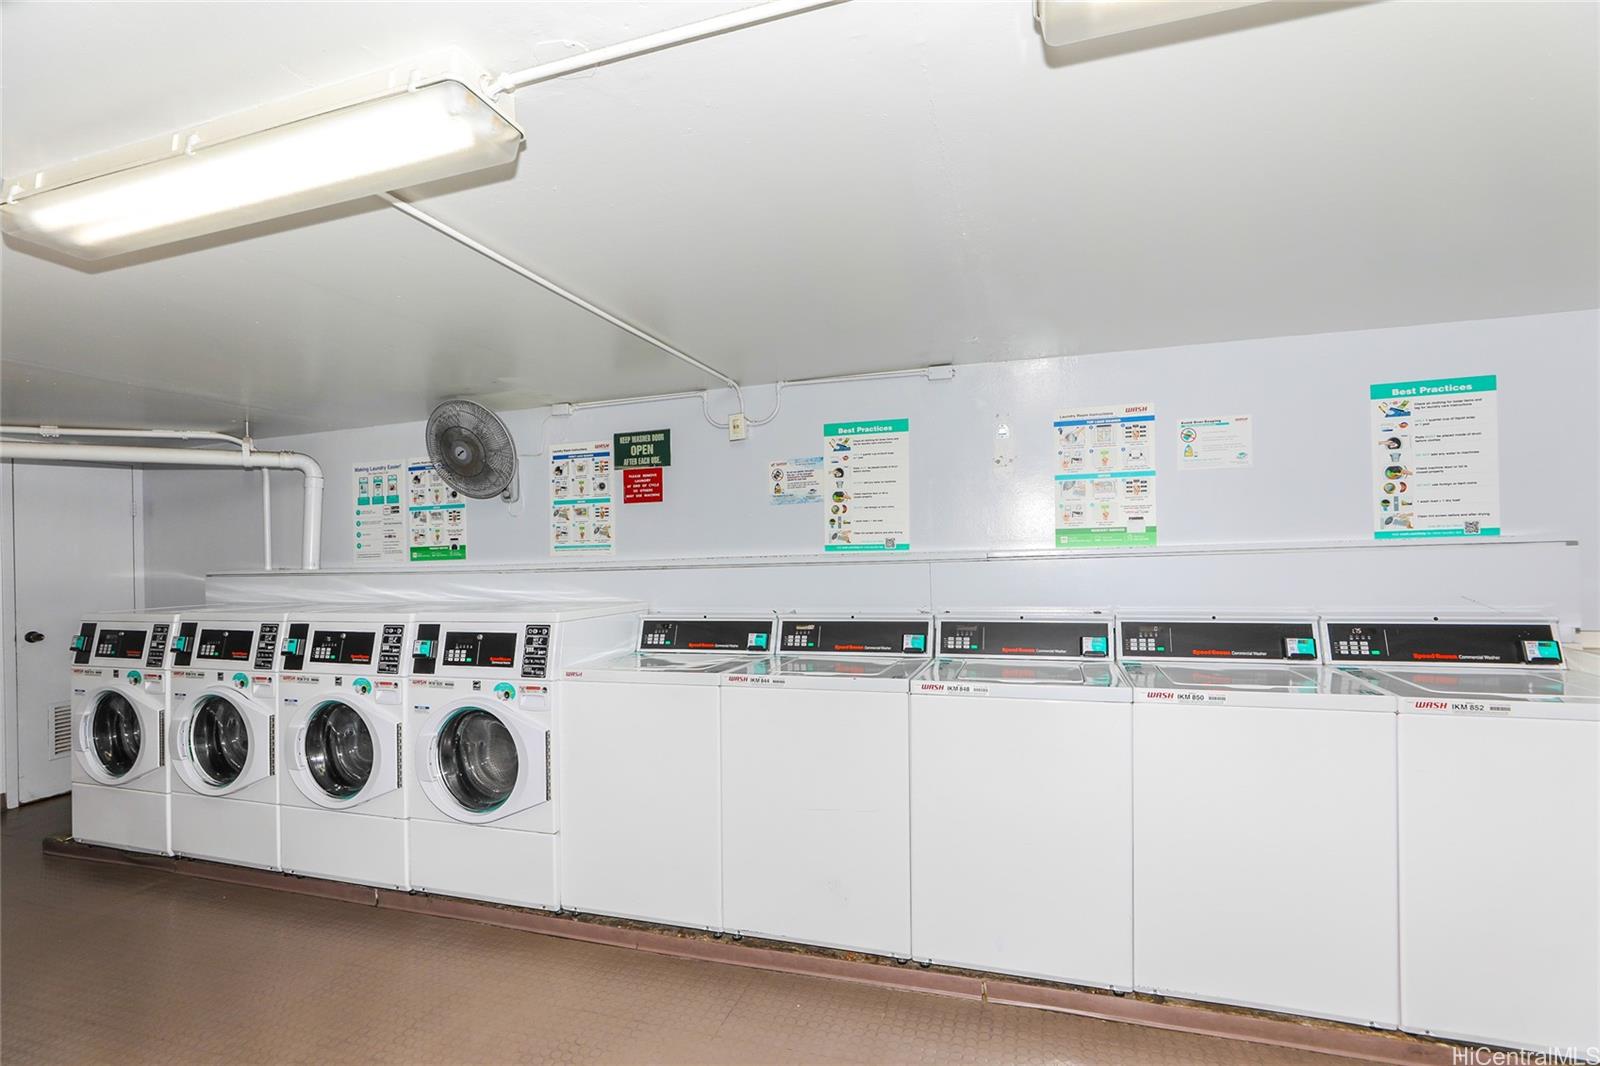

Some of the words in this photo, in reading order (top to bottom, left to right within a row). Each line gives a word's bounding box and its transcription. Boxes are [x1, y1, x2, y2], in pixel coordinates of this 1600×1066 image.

[1392, 386, 1416, 396] Best
[1420, 384, 1472, 394] Practices
[856, 425, 893, 433] Practices
[620, 436, 630, 444] KEEP
[632, 434, 651, 443] WASHER
[652, 433, 664, 442] DOOR
[630, 444, 654, 456] OPEN
[624, 458, 637, 466] AFTER
[638, 456, 650, 465] EACH
[1415, 701, 1448, 710] WASH
